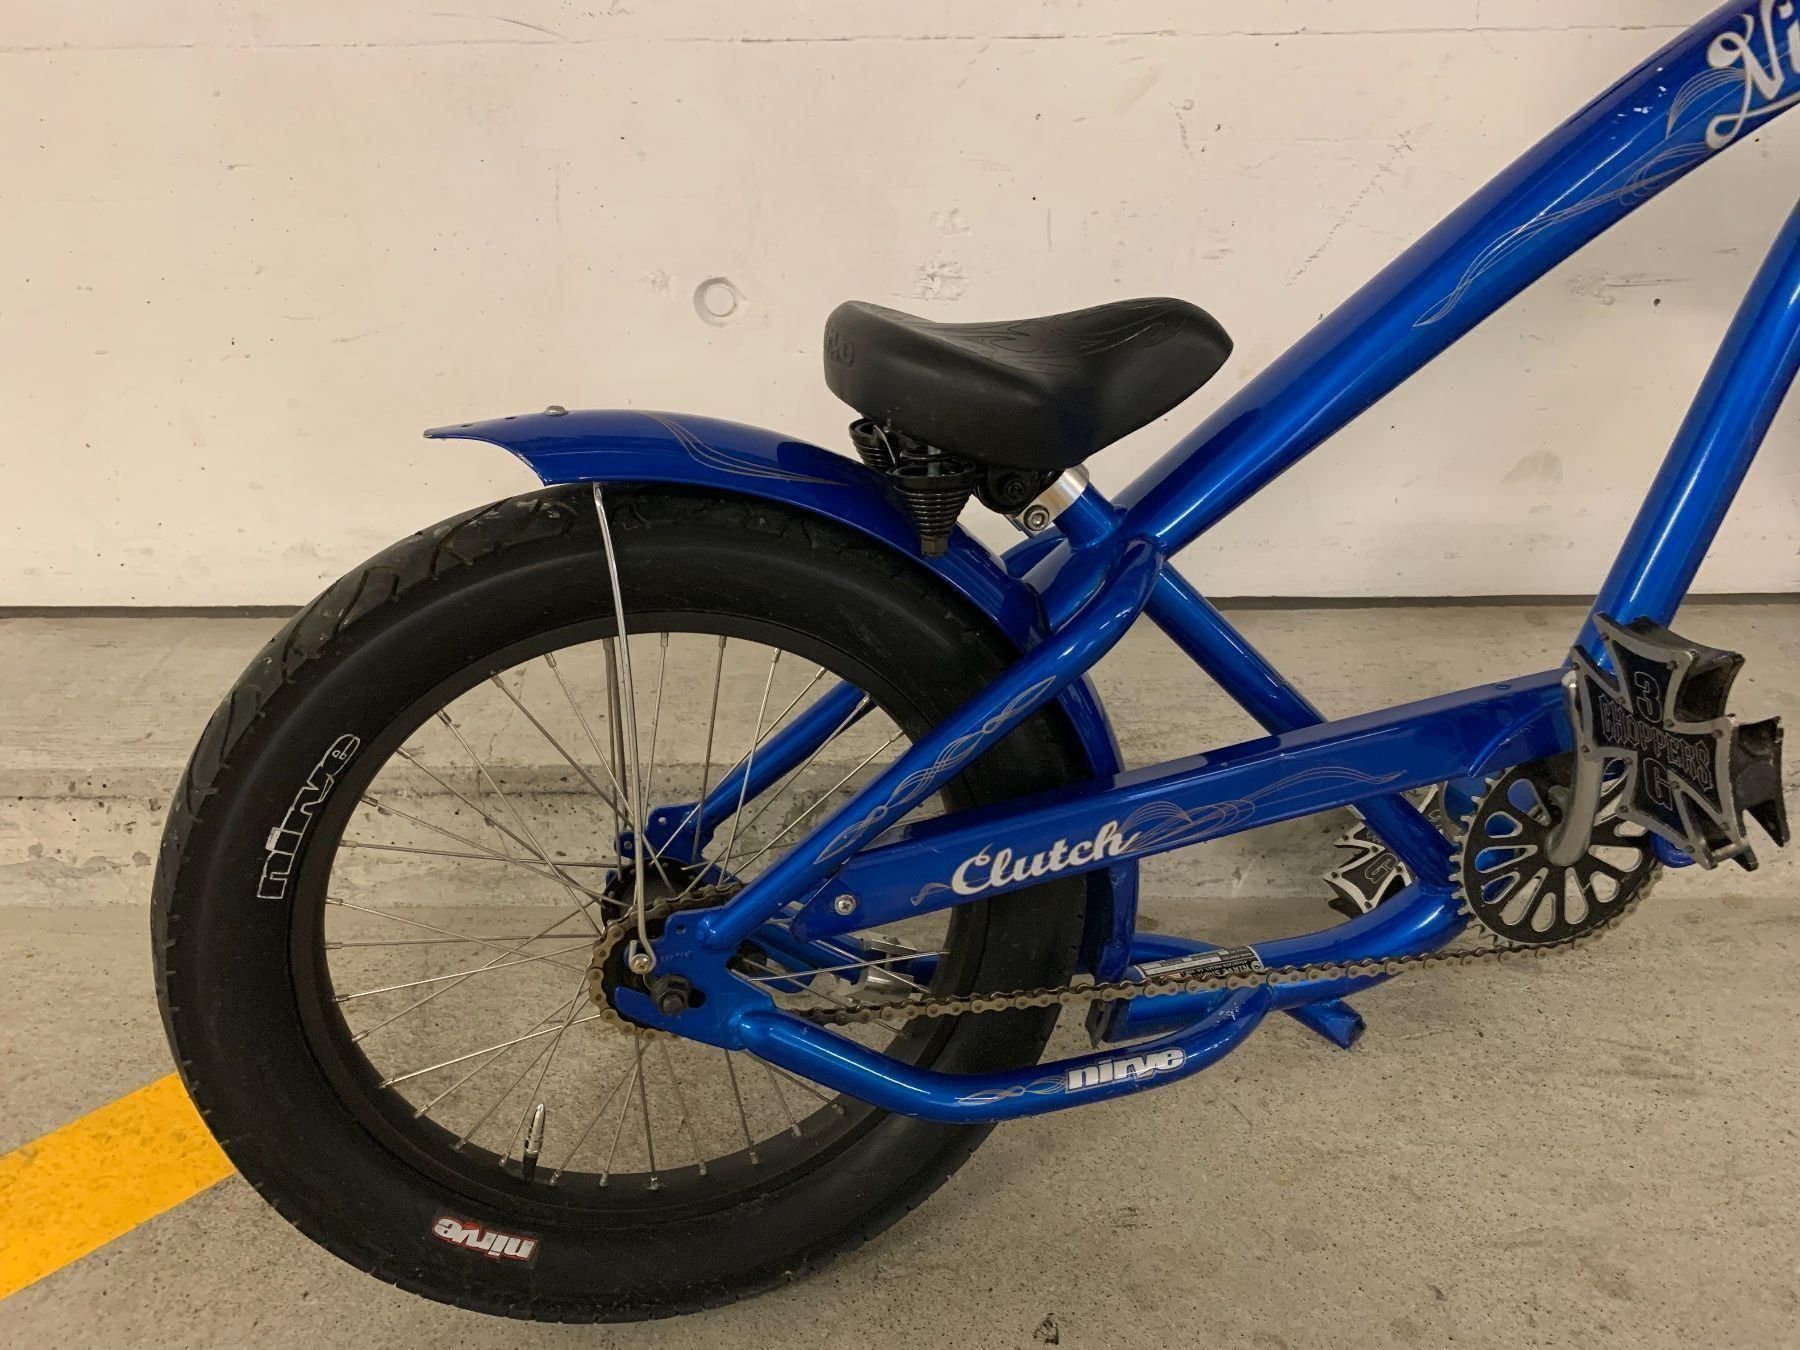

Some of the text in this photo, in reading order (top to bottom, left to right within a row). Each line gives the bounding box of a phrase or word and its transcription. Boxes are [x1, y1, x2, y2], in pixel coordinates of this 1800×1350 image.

[1597, 692, 1713, 792] CHOPPERS
[256, 733, 361, 899] nirve
[951, 819, 1142, 896] Clutch
[1065, 1047, 1186, 1093] nirve
[432, 1216, 539, 1261] nirve
